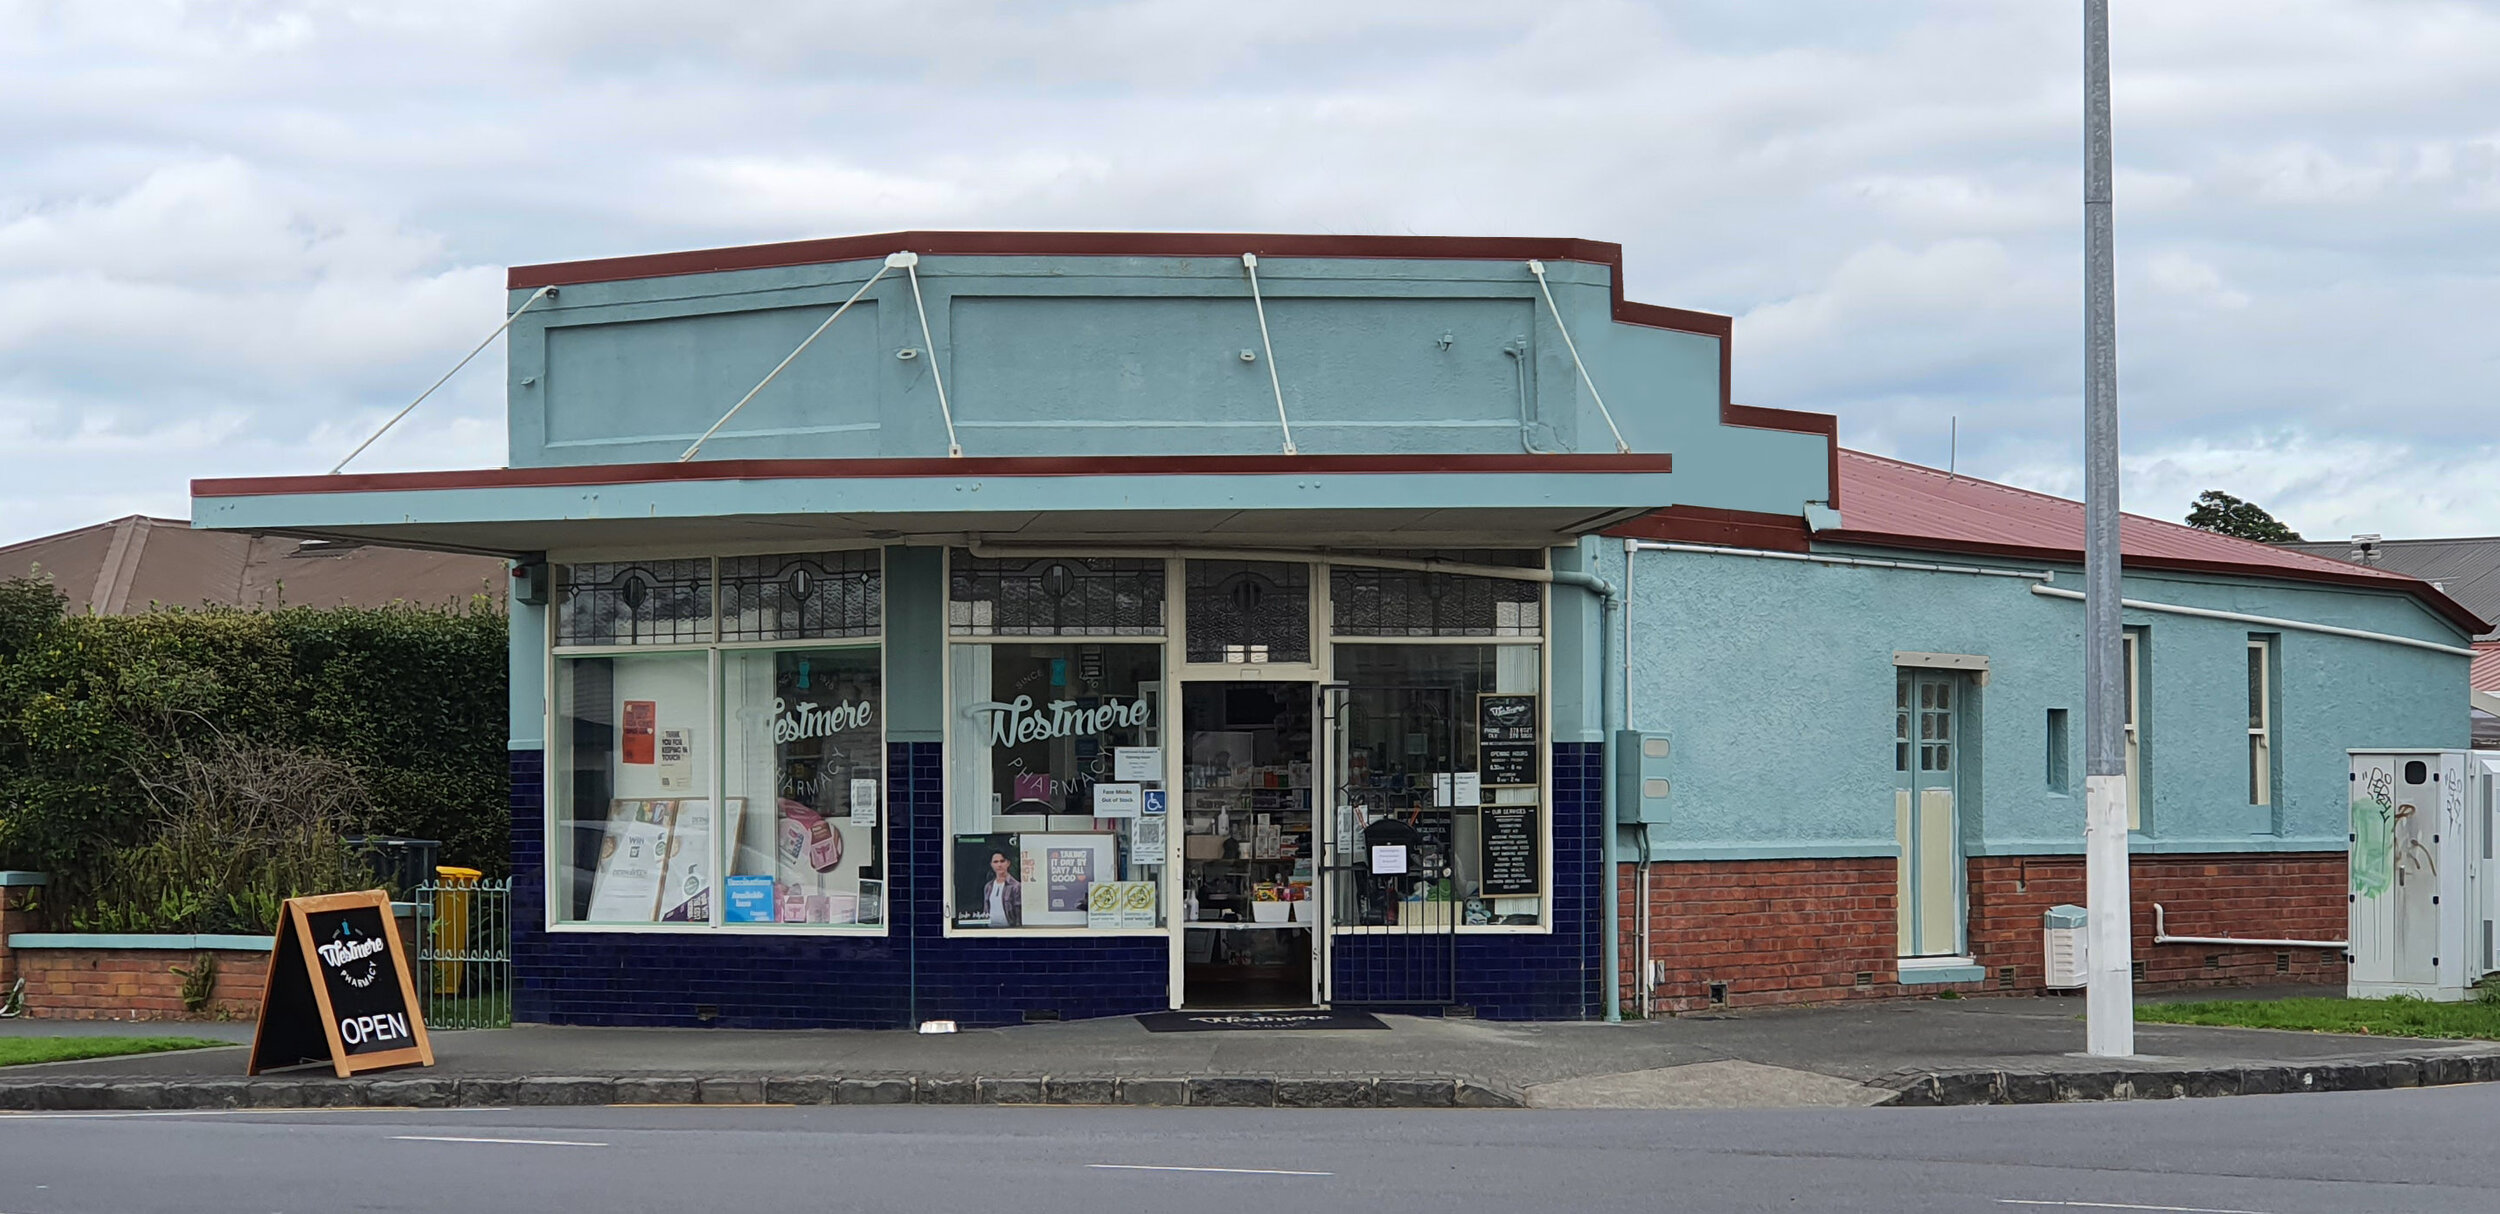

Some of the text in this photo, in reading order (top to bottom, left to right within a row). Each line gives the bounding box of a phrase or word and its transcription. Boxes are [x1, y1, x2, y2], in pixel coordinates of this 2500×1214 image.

[963, 694, 1151, 749] Westmere
[661, 746, 682, 754] KEEPING
[662, 738, 683, 746] YOU FOR
[776, 746, 845, 797] HARMACY
[1007, 744, 1113, 796] PHARMACY
[1051, 874, 1077, 883] GOOD
[1072, 866, 1085, 875] ALL
[317, 937, 384, 968] Westmere
[340, 960, 378, 988] PHARMACY
[341, 1012, 408, 1045] OPEN
